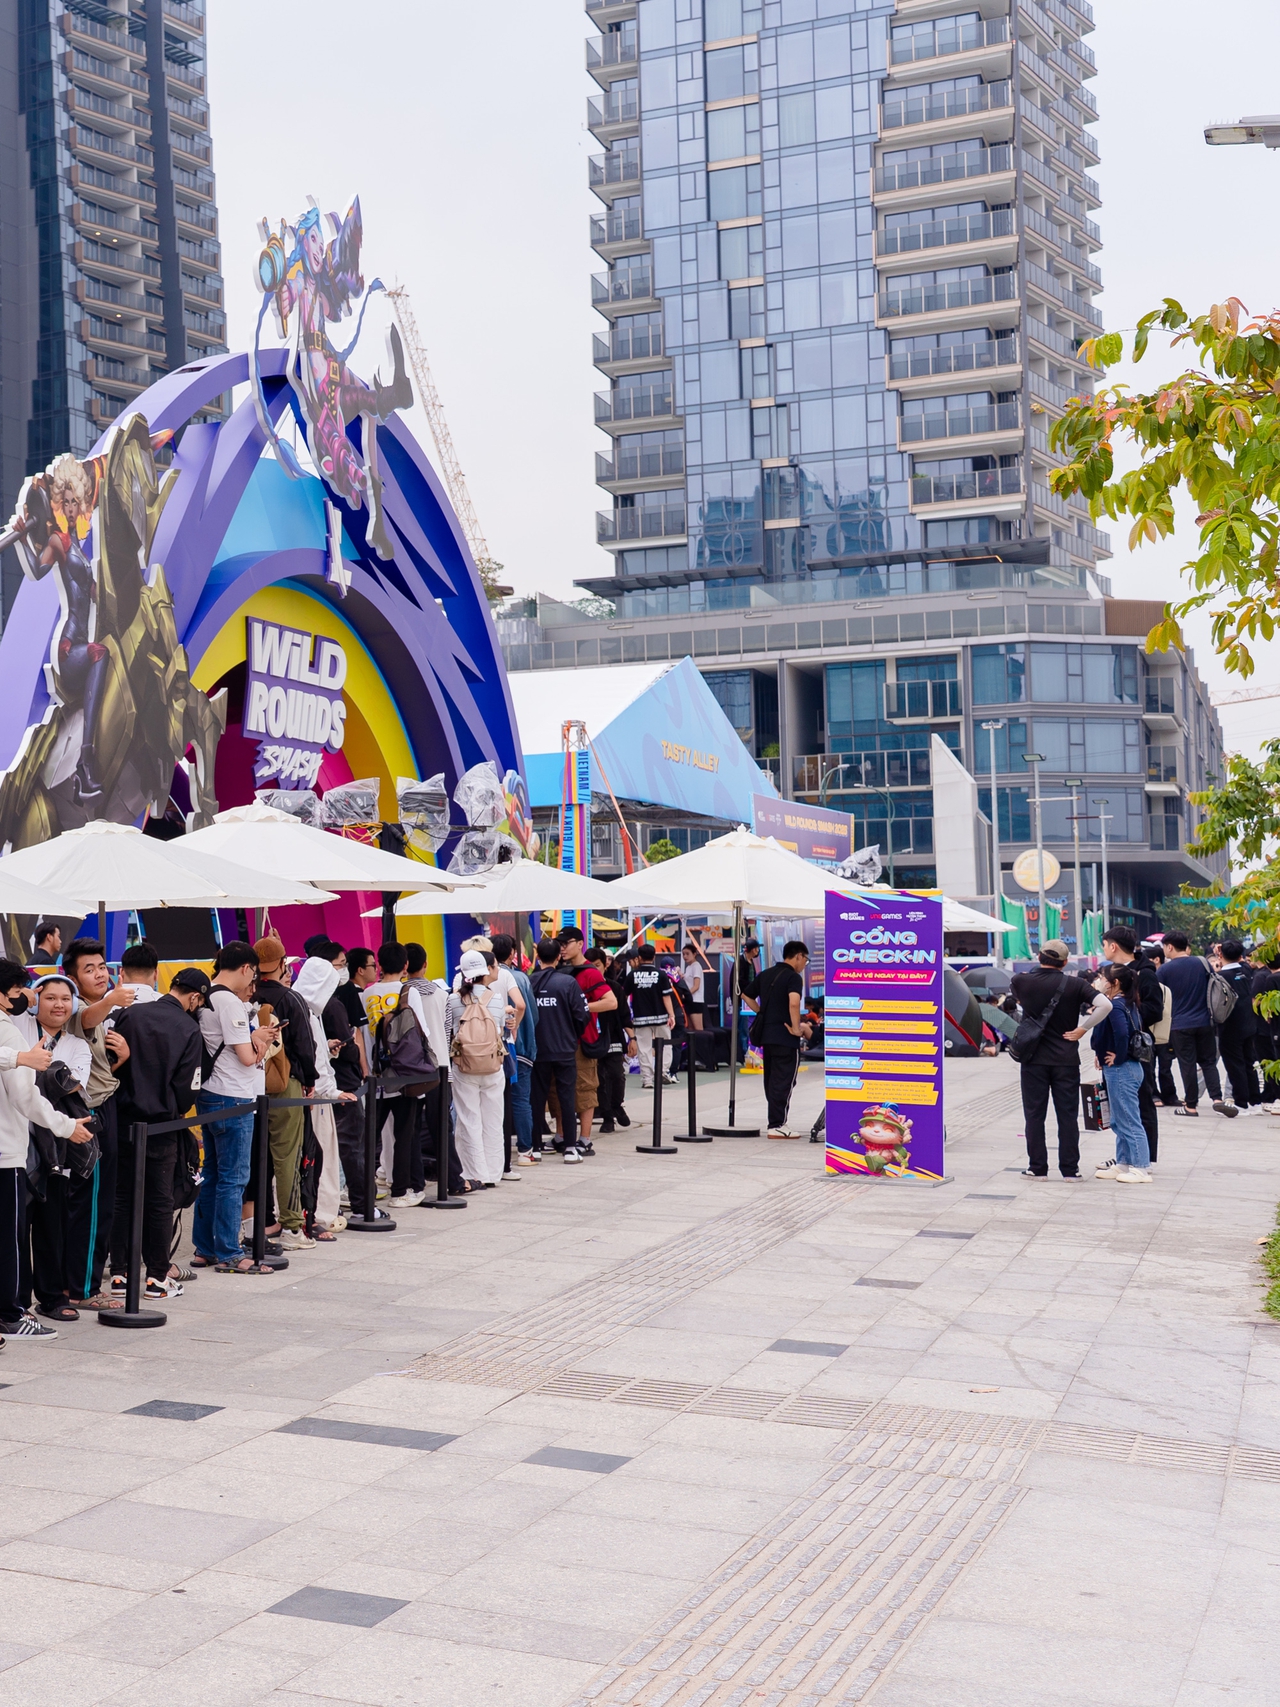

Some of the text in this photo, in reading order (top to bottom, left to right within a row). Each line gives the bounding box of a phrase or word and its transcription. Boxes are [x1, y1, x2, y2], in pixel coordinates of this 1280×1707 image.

[255, 744, 324, 789] SMASH
[661, 739, 719, 774] TASTY ALLEY
[577, 751, 589, 790] VIETNAM
[563, 818, 574, 841] GLORY
[849, 925, 918, 946] CỔNG
[832, 948, 937, 964] CHECK-IN
[839, 972, 862, 980] NHẬN
[536, 997, 557, 1007] KER
